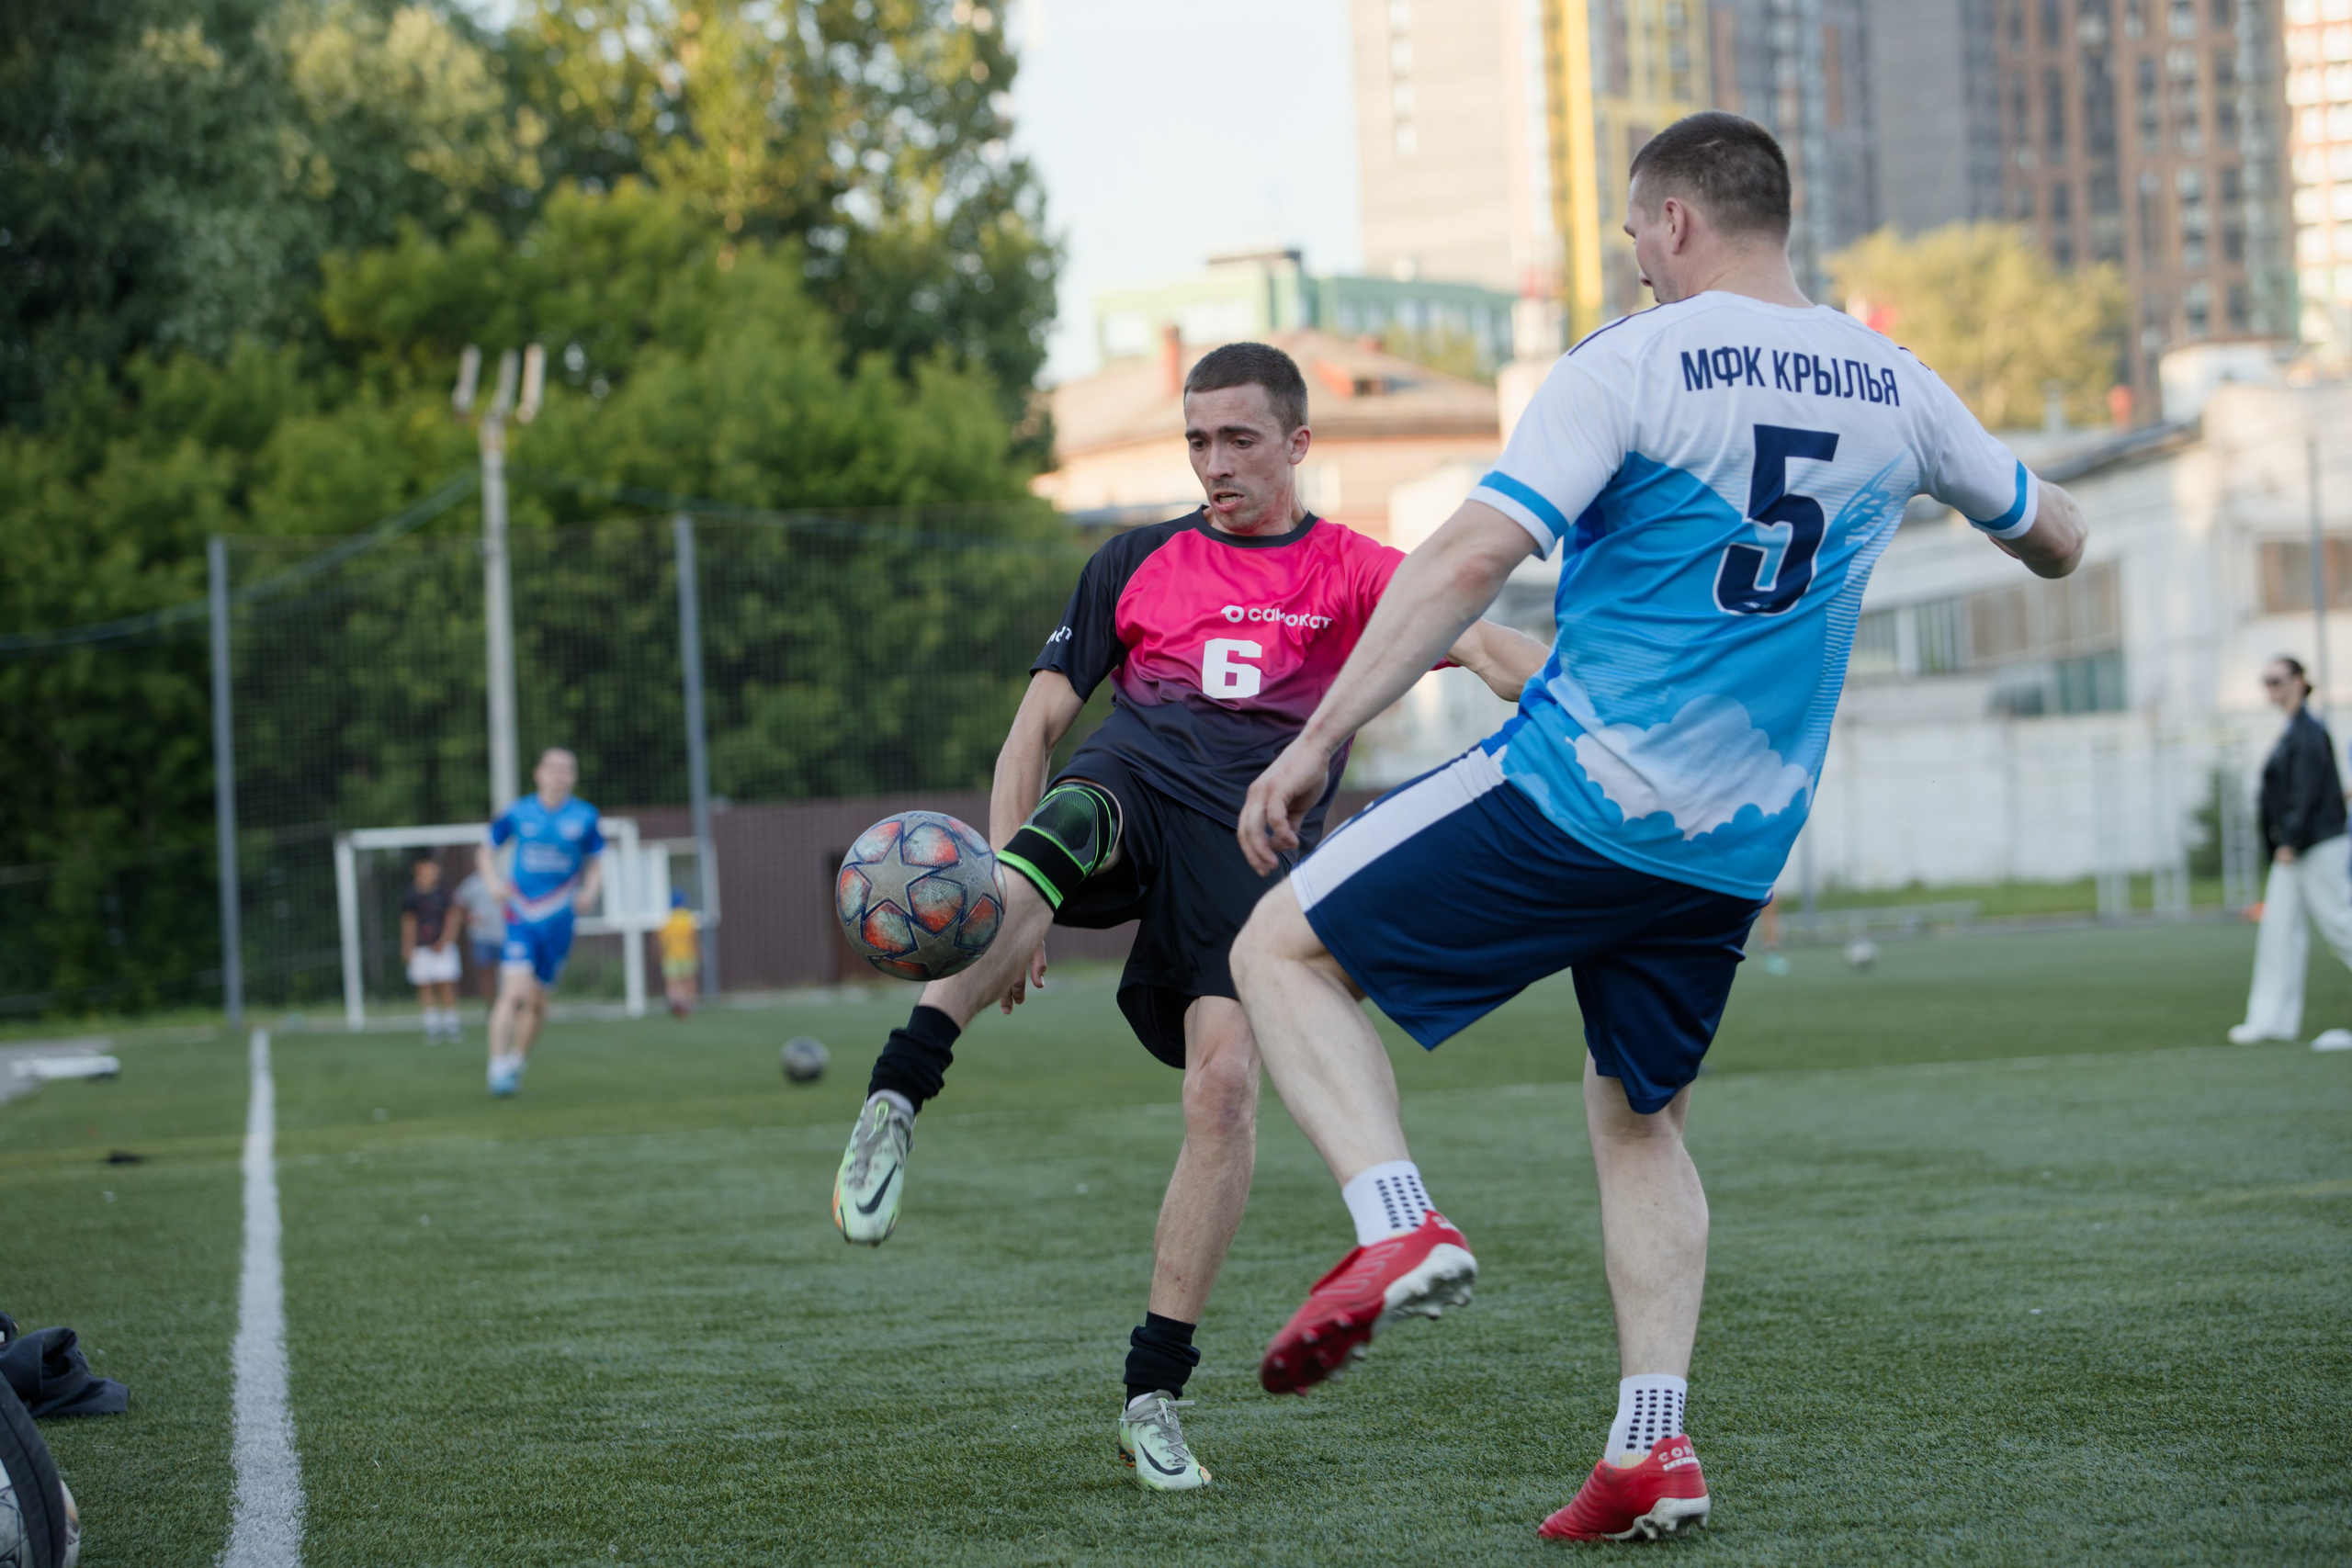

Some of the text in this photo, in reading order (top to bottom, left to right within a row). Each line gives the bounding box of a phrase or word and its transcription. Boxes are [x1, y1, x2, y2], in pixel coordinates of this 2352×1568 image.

[1680, 345, 1901, 407] МФК КРЫЛЬЯ
[1712, 423, 1840, 617] 5
[1202, 637, 1262, 700] 6
